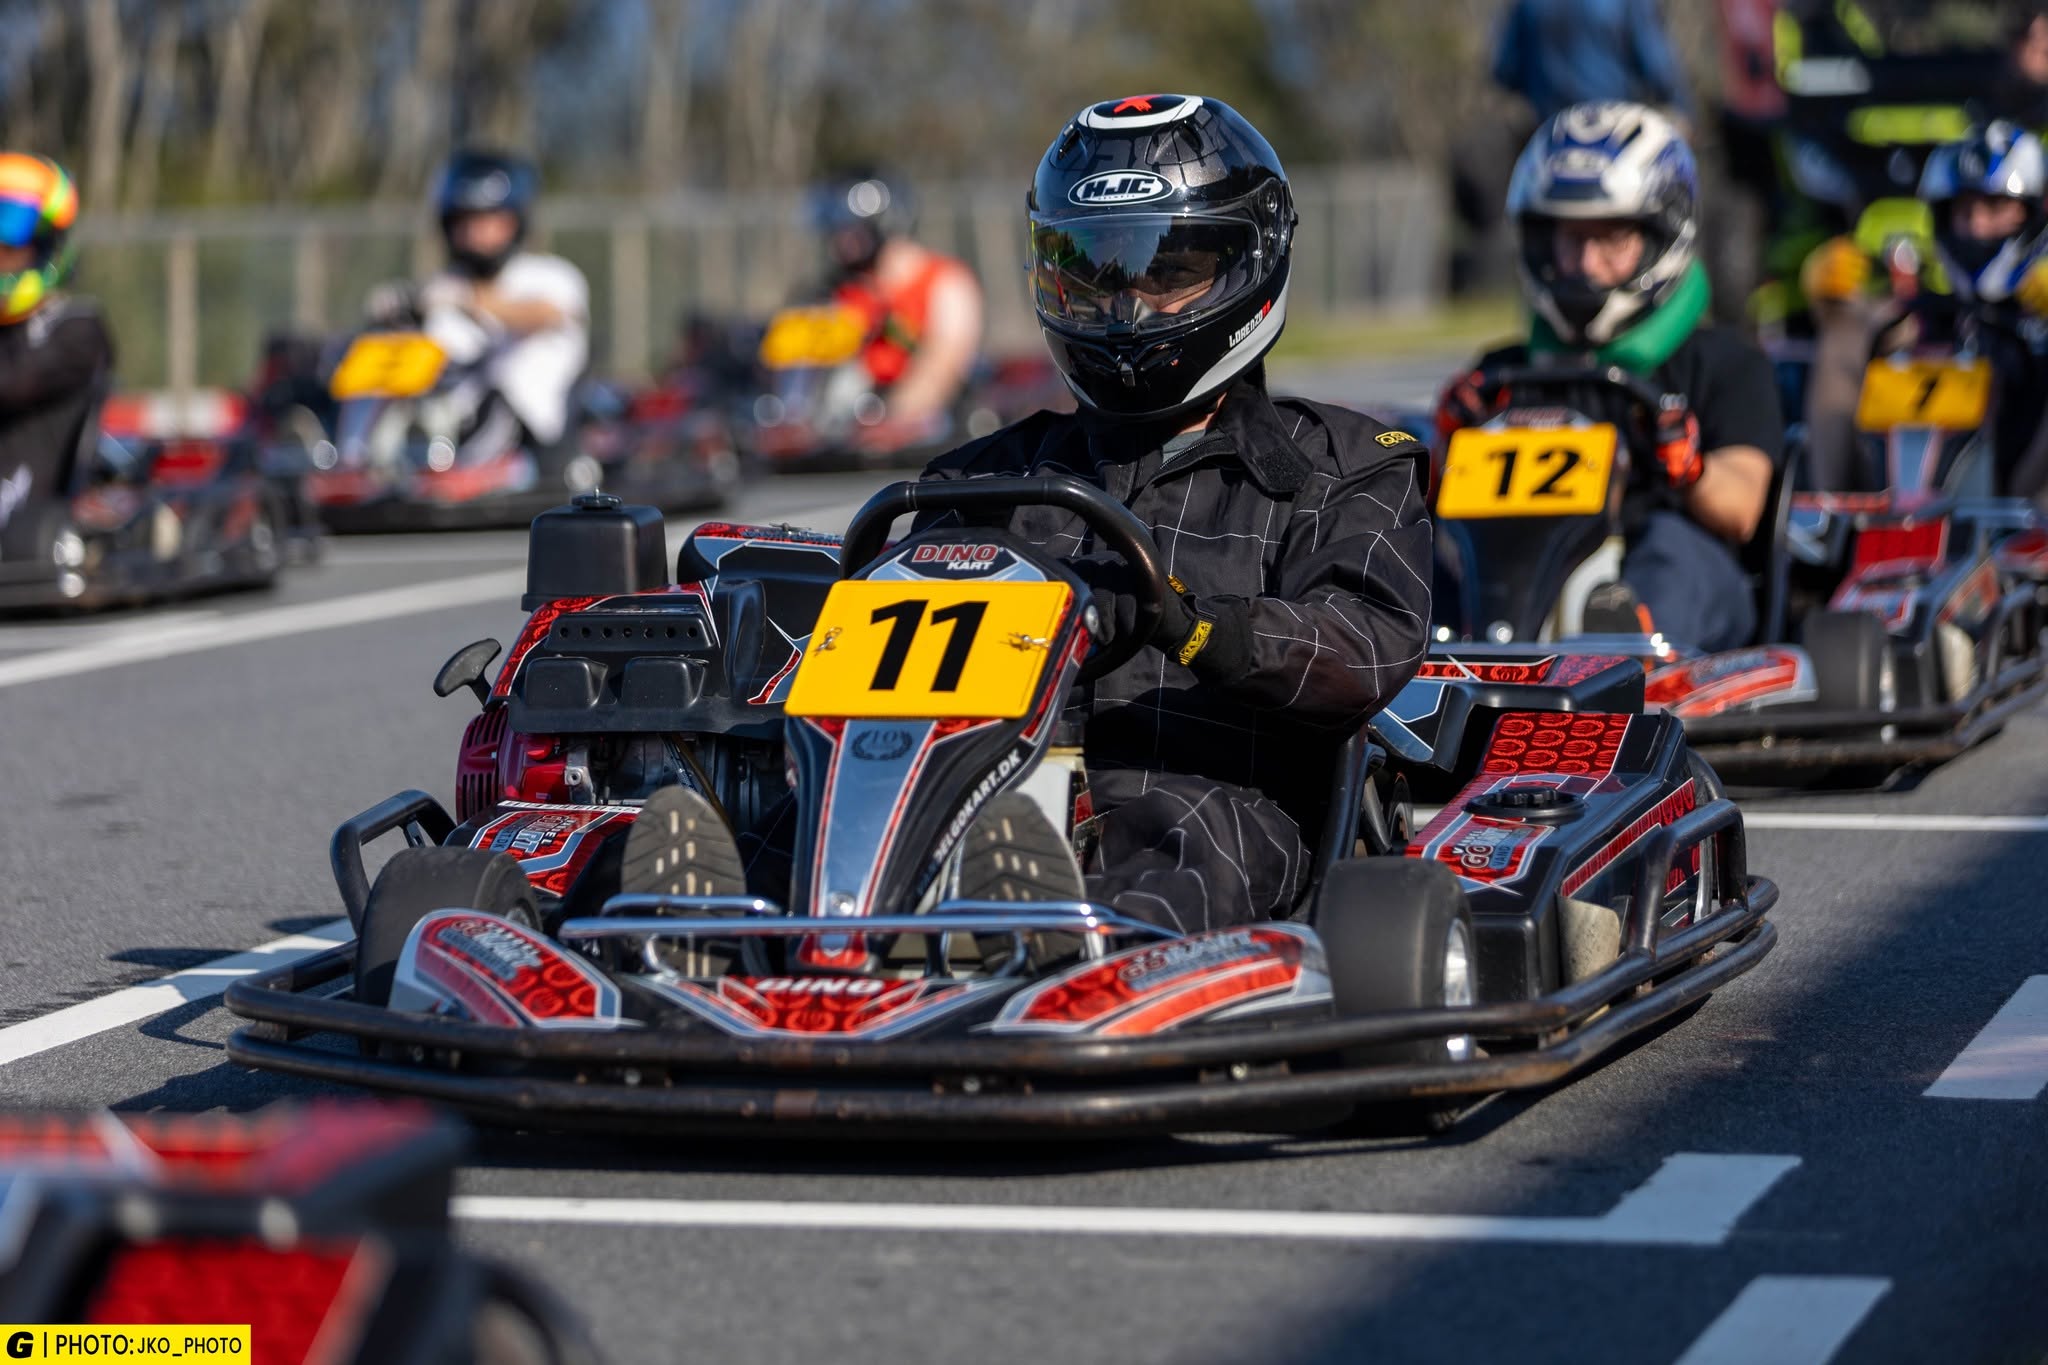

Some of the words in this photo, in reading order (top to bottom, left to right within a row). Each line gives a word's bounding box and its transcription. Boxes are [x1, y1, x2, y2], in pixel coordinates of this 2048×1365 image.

[1081, 177, 1156, 199] HJC
[1486, 447, 1581, 498] 12
[911, 544, 999, 562] DINO
[946, 561, 994, 570] KART
[868, 599, 989, 692] 11
[755, 978, 884, 994] DINO
